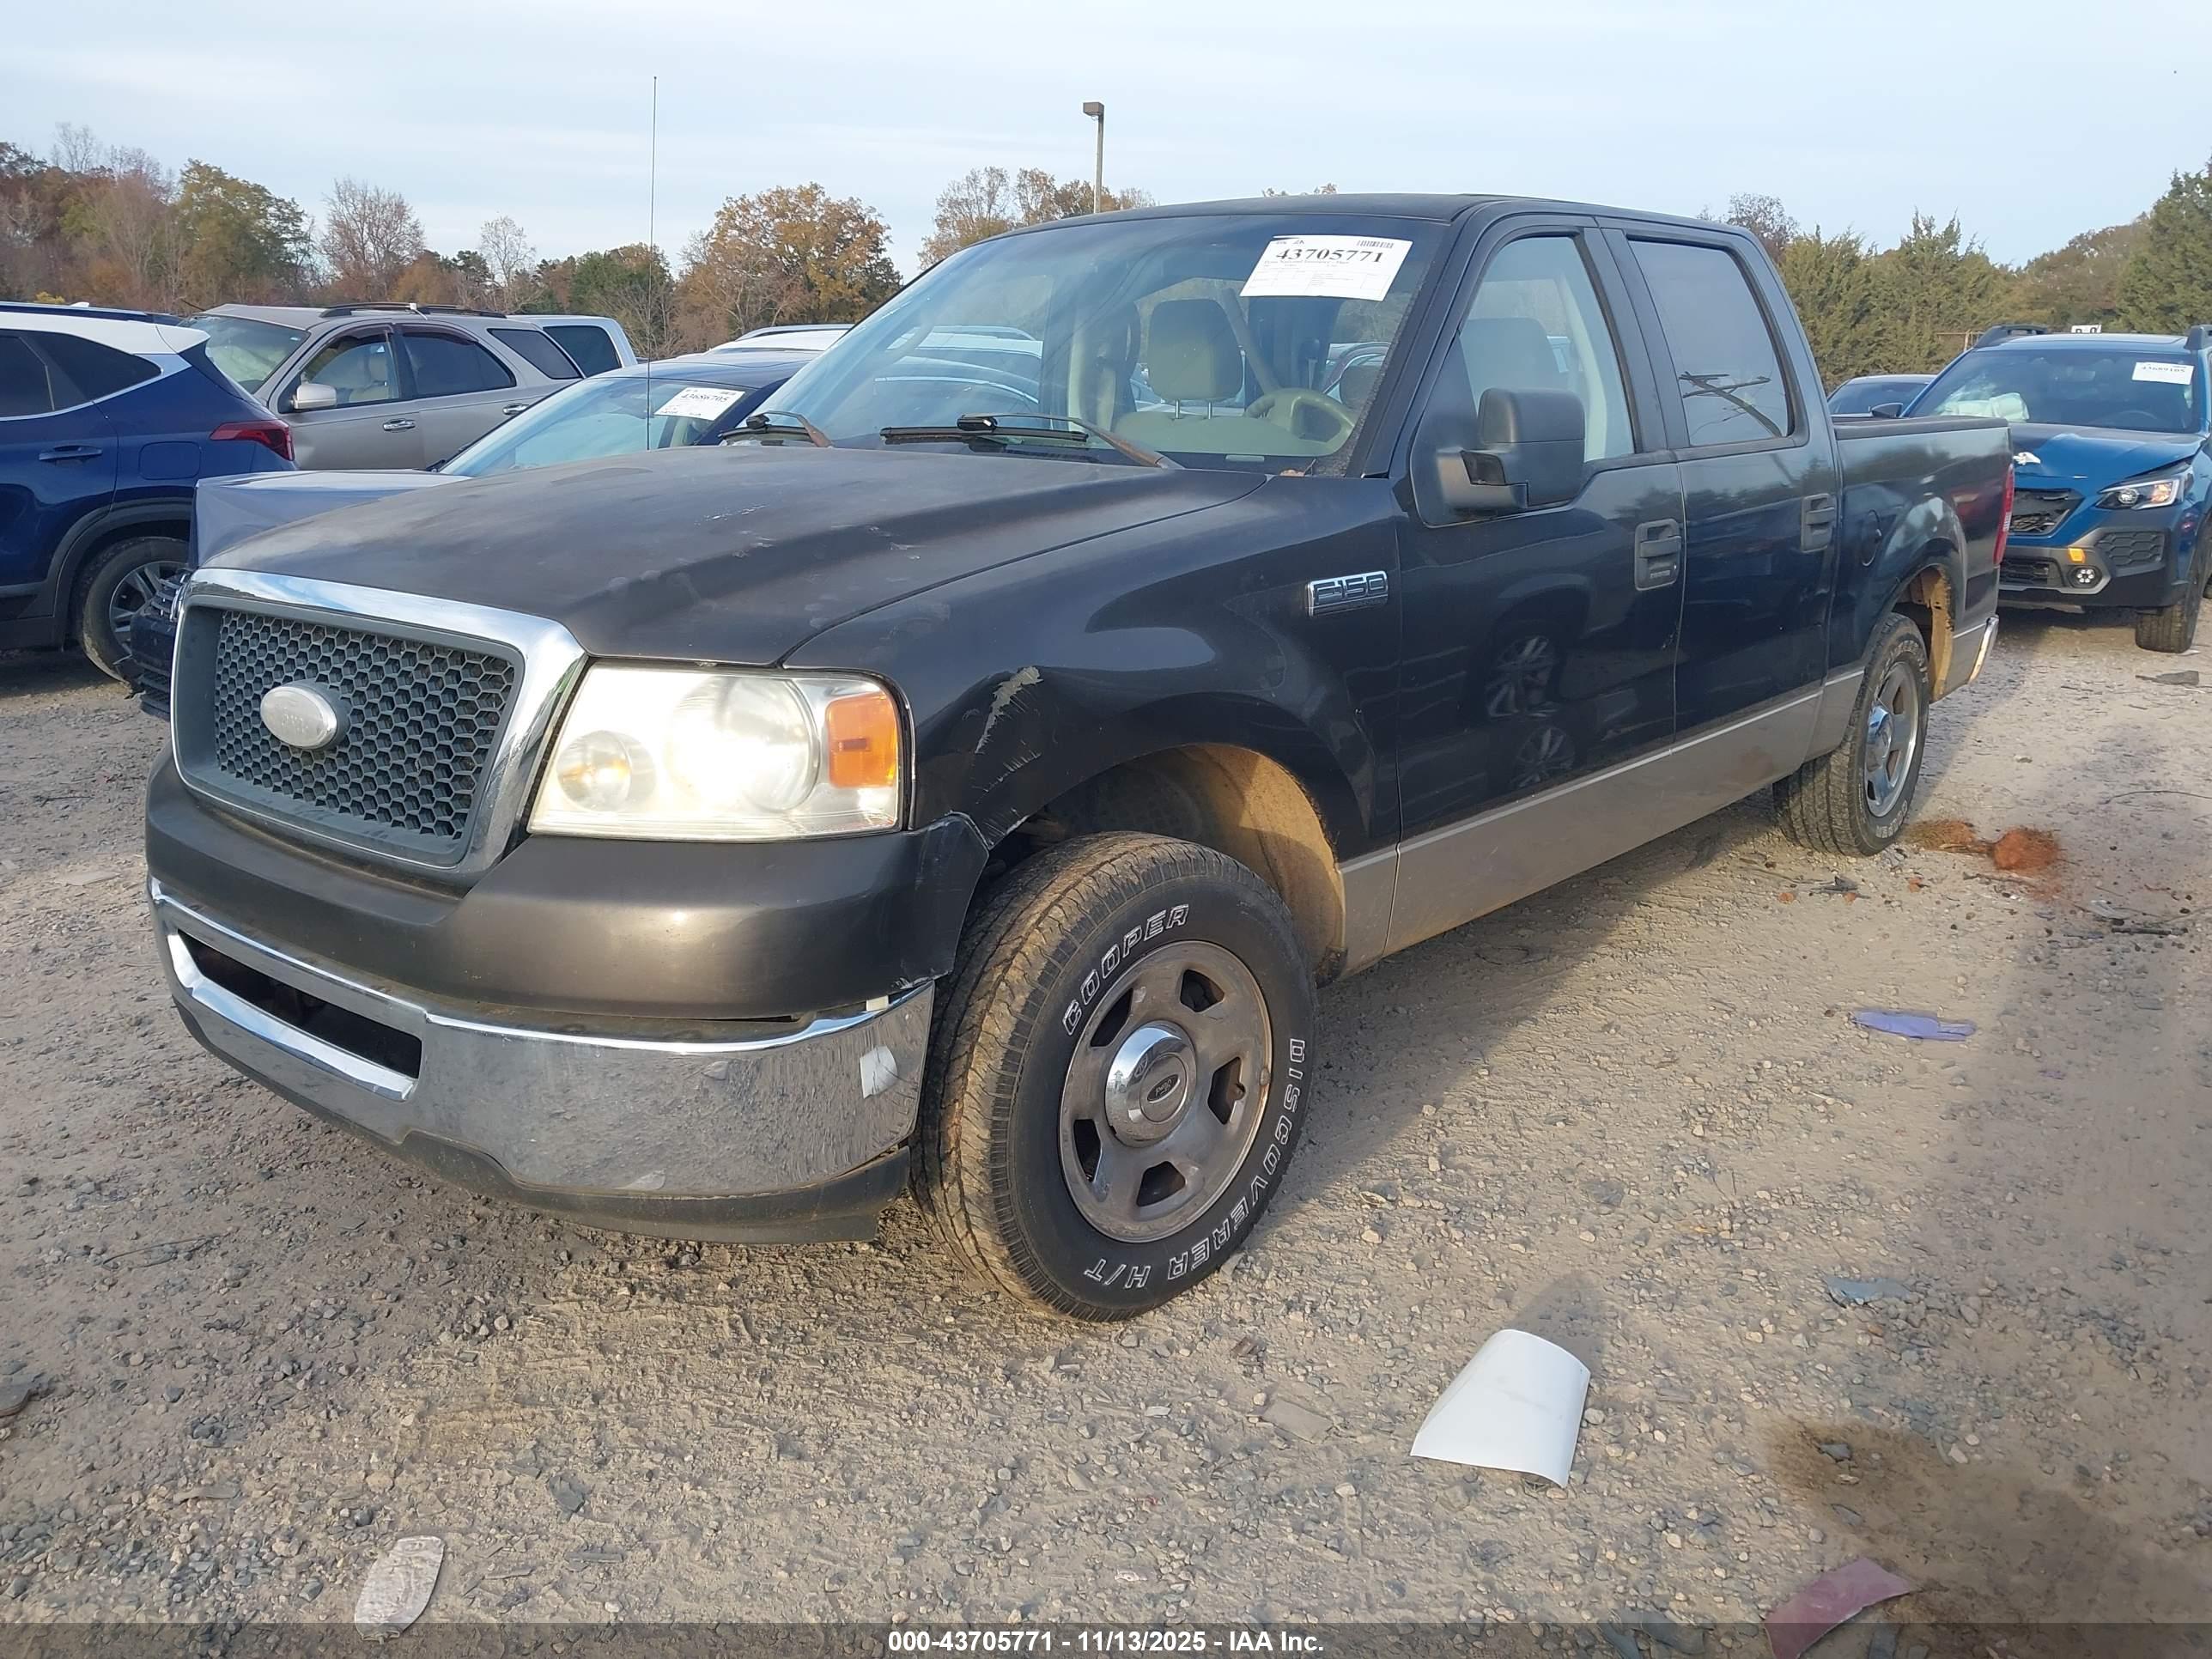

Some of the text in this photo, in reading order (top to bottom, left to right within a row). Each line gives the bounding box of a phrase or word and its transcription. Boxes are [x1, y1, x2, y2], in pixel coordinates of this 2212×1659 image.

[1275, 247, 1383, 263] 43705771
[1062, 903, 1189, 1036] COOPER
[1168, 1037, 1306, 1280] DISCOVERER
[1084, 1257, 1152, 1289] H/T
